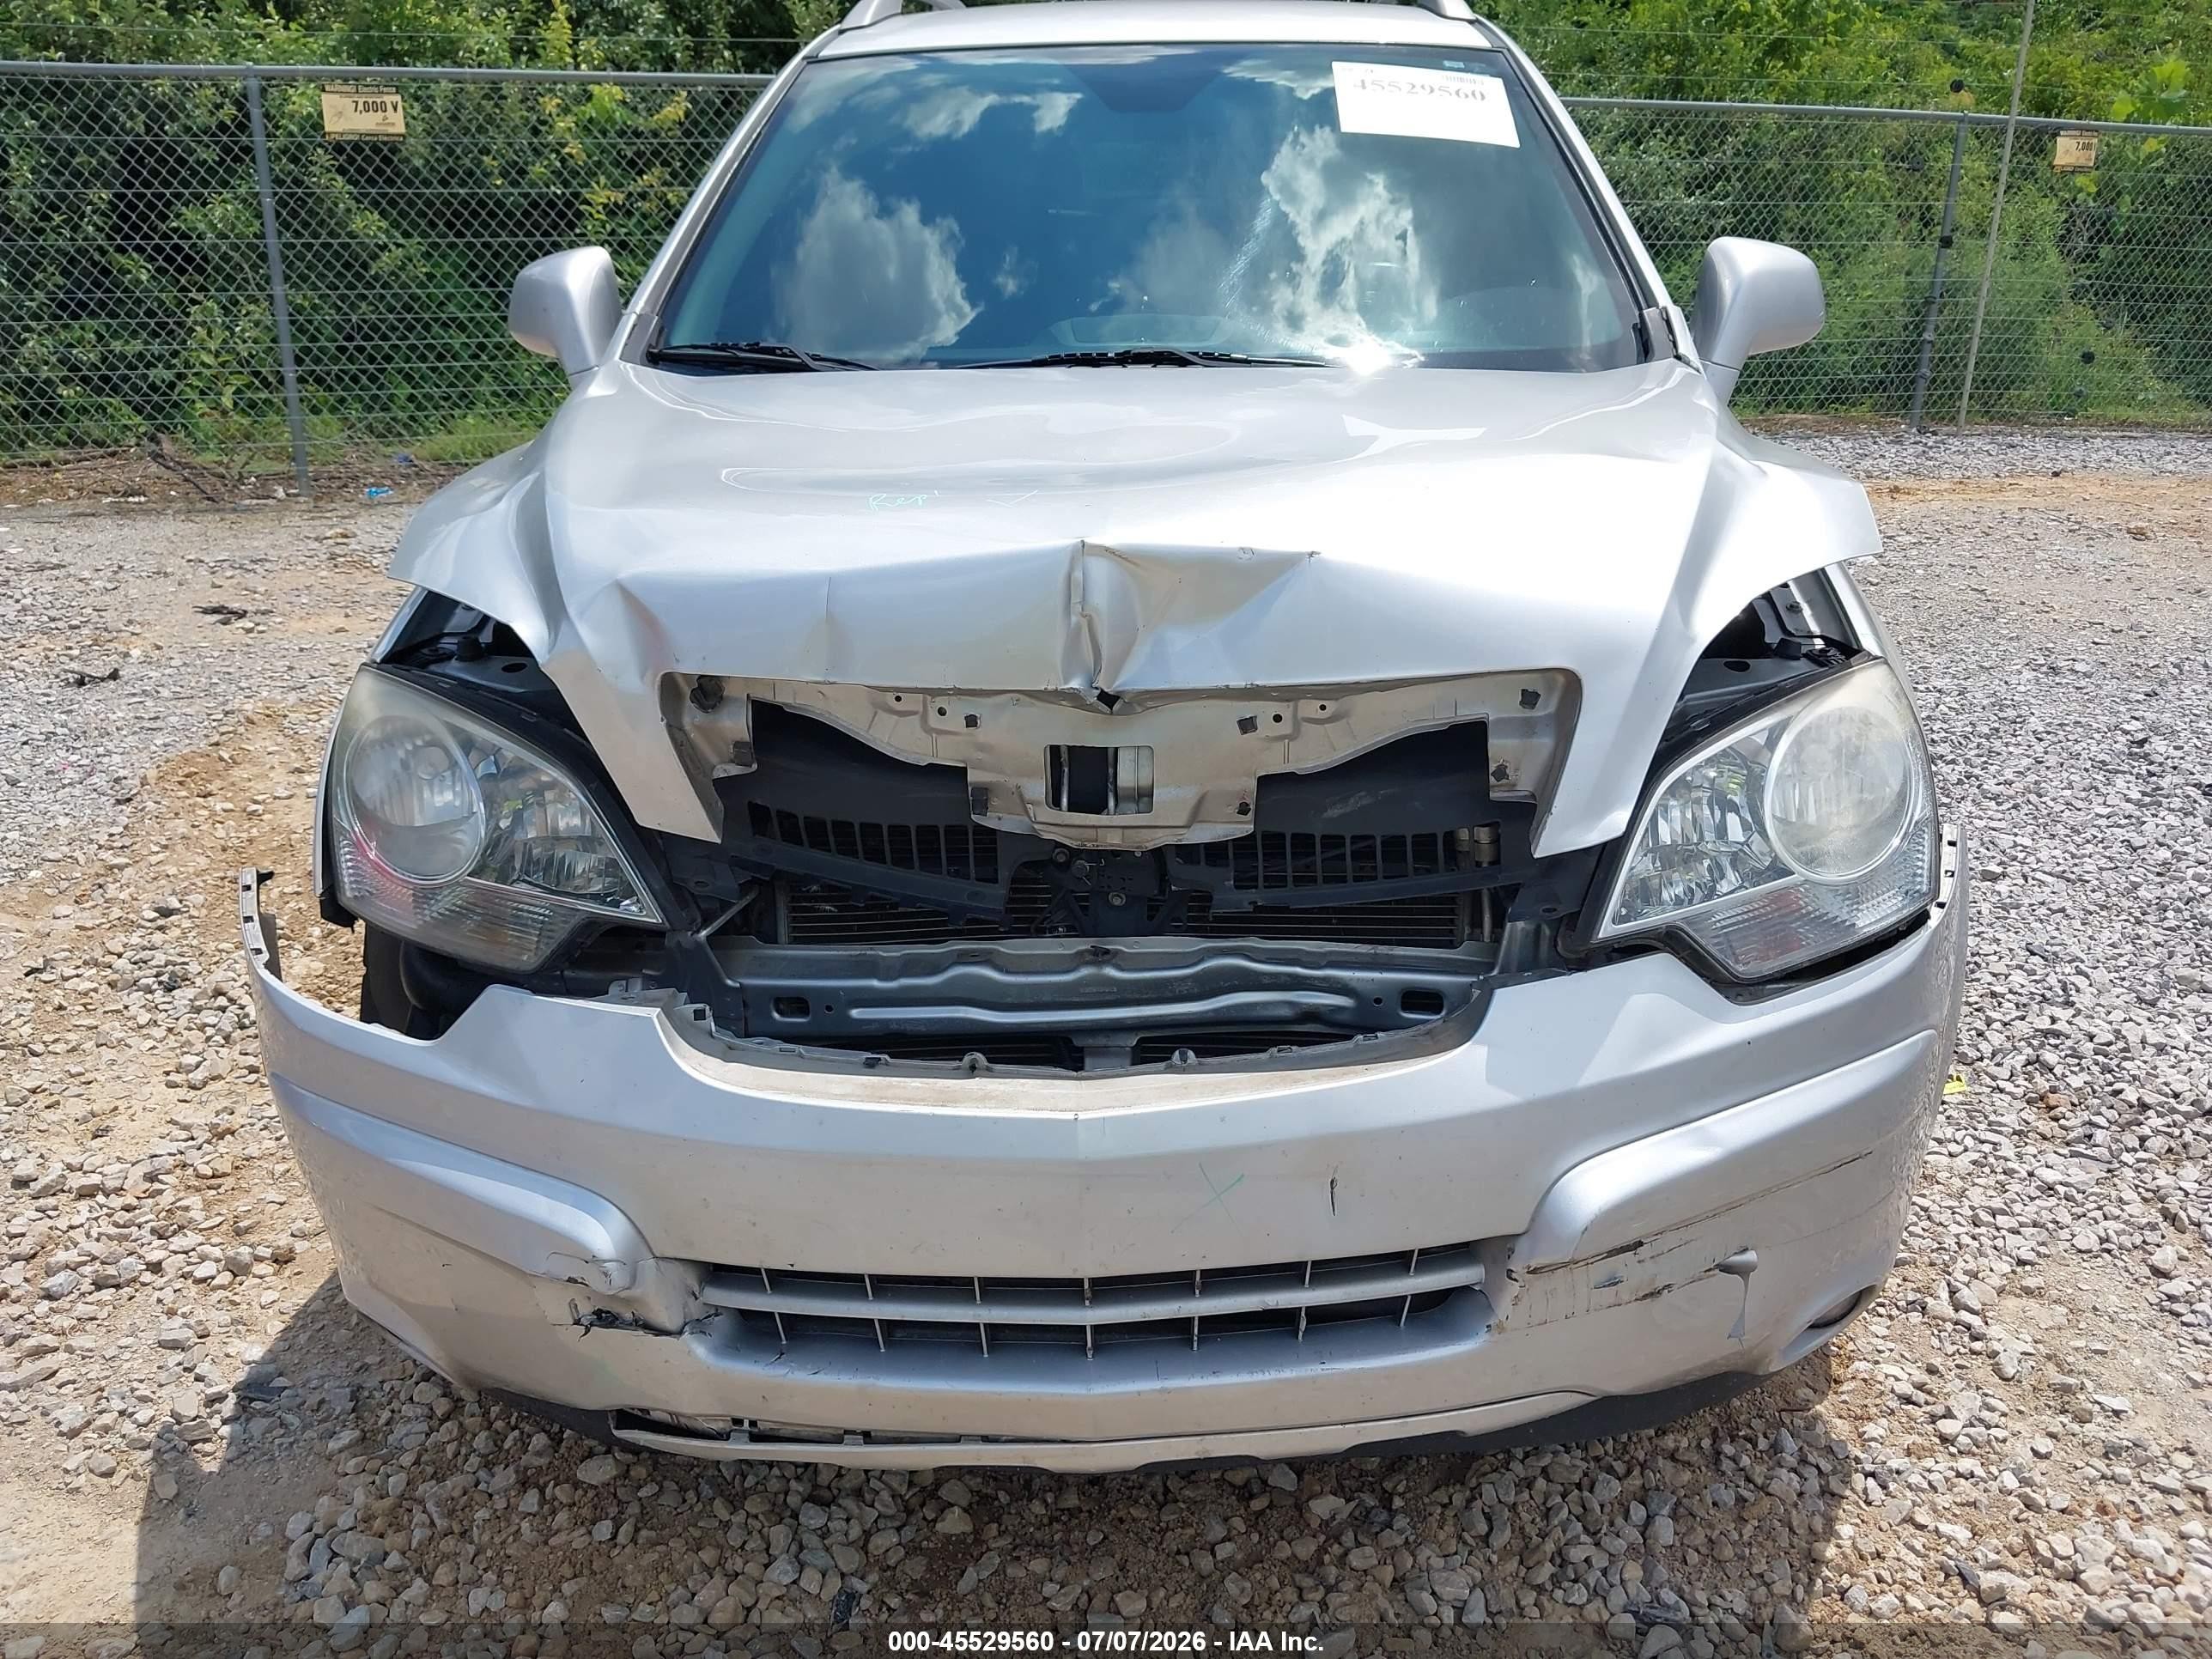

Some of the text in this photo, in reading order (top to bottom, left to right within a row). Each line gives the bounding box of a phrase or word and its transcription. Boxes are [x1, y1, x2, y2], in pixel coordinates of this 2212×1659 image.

[1353, 78, 1486, 101] 45529560
[351, 100, 398, 115] 7,000 V
